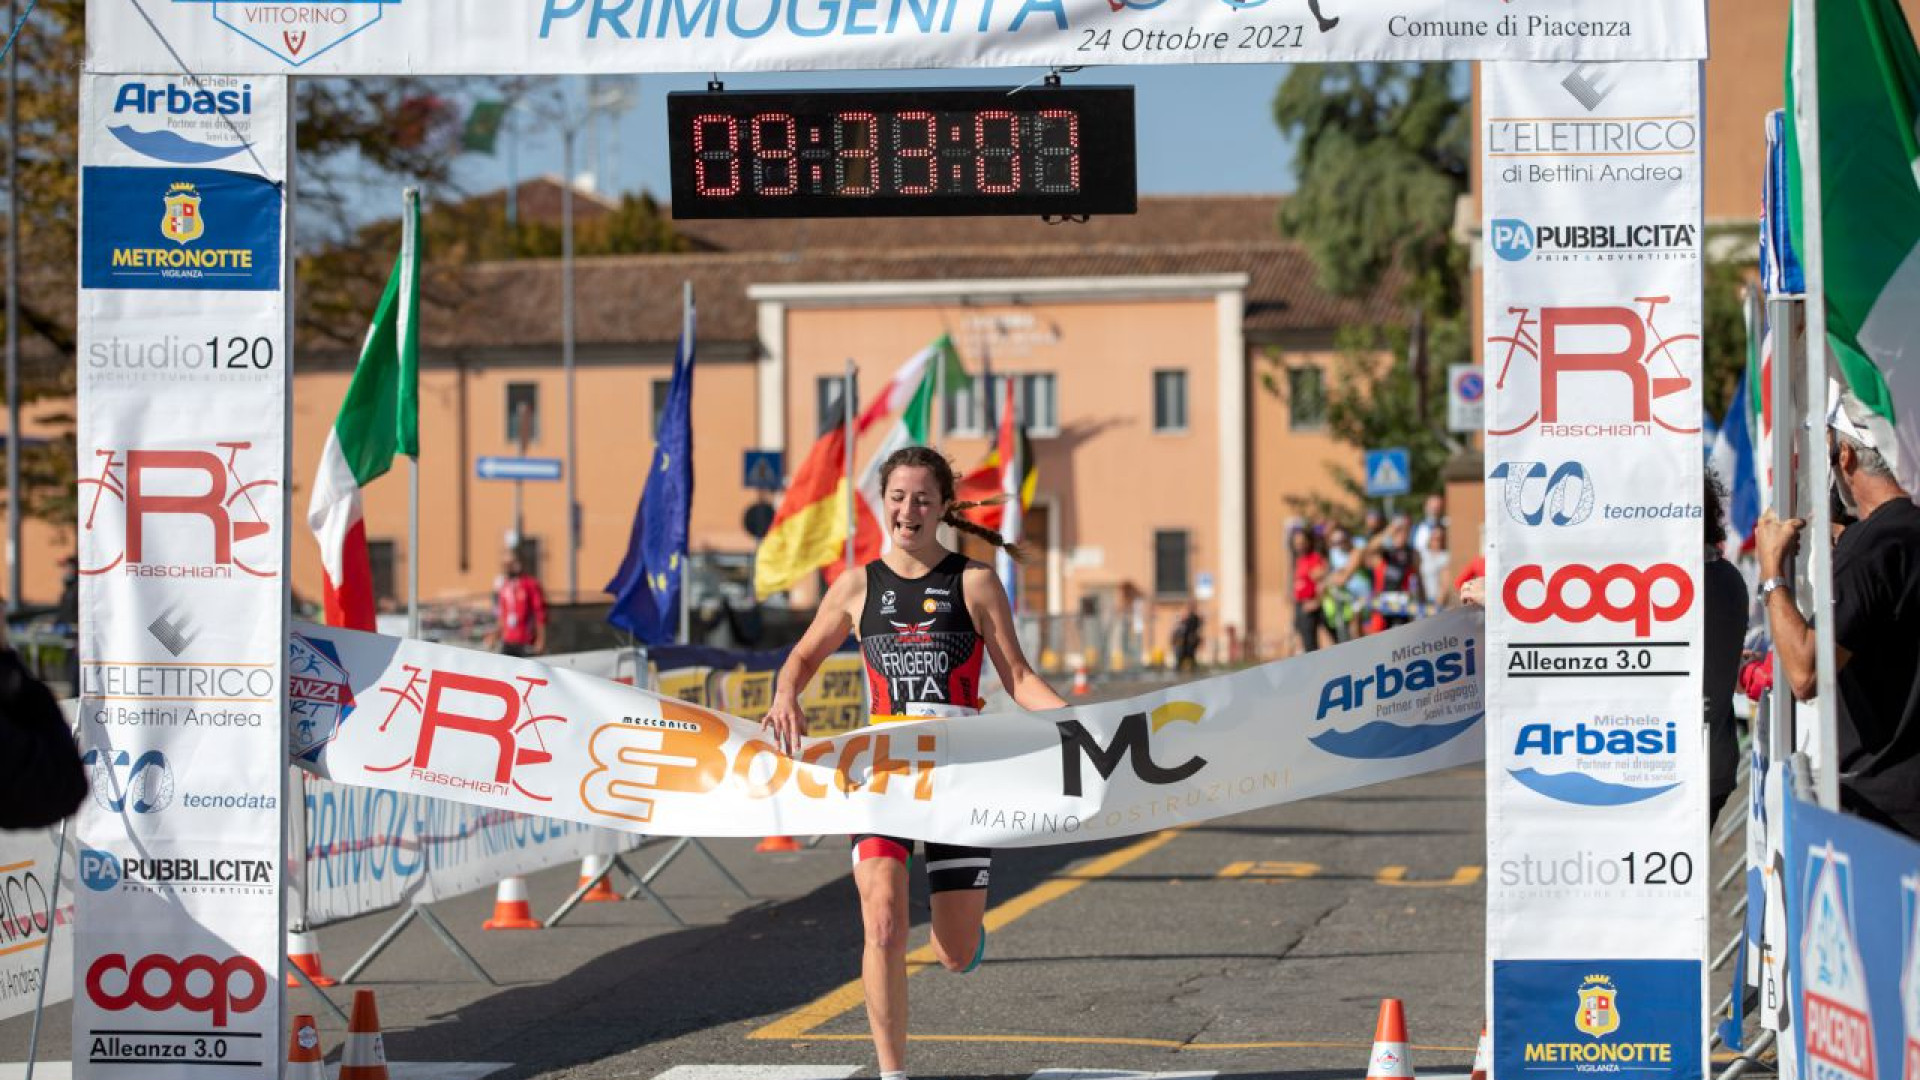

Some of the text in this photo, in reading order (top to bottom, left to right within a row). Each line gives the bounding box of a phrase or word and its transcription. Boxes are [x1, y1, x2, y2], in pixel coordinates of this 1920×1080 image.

[245, 7, 347, 24] VITTORINO
[538, 0, 1069, 40] PRIMOGENITA
[1388, 15, 1632, 37] Comune di Piacenza
[1077, 25, 1304, 51] 24 Ottobre 2021
[182, 76, 238, 87] Michele
[113, 83, 252, 115] Arbasi
[1490, 121, 1696, 152] L'ELETTRICO
[693, 109, 1080, 197] 09:33:07
[1502, 164, 1682, 183] di Bettini Andrea
[1495, 227, 1531, 250] PA
[112, 248, 252, 268] METRONOTTE
[1536, 254, 1579, 262] PRINT
[161, 269, 204, 278] VIGILANZA
[88, 335, 274, 370] studio120
[1603, 503, 1702, 519] tecnodata
[1502, 563, 1695, 637] coop
[1391, 636, 1459, 663] Michele
[1508, 649, 1652, 670] Alleanza 3.0
[882, 650, 949, 676] FRIGERIO
[83, 667, 274, 697] L'ELETTRICO
[892, 676, 946, 701] ITA
[1316, 638, 1476, 720] Arbasi
[95, 708, 262, 727] di Bettini Andrea
[623, 716, 697, 731] meccanica
[1594, 715, 1660, 726] Michele
[1514, 722, 1677, 755] Arbasi
[184, 792, 277, 809] tecnodata
[83, 857, 118, 880] PA
[1500, 851, 1693, 885] studio120
[85, 953, 267, 1028] coop
[89, 1037, 227, 1058] Alleanza 3.0
[1525, 1043, 1672, 1062] METRONOTTE
